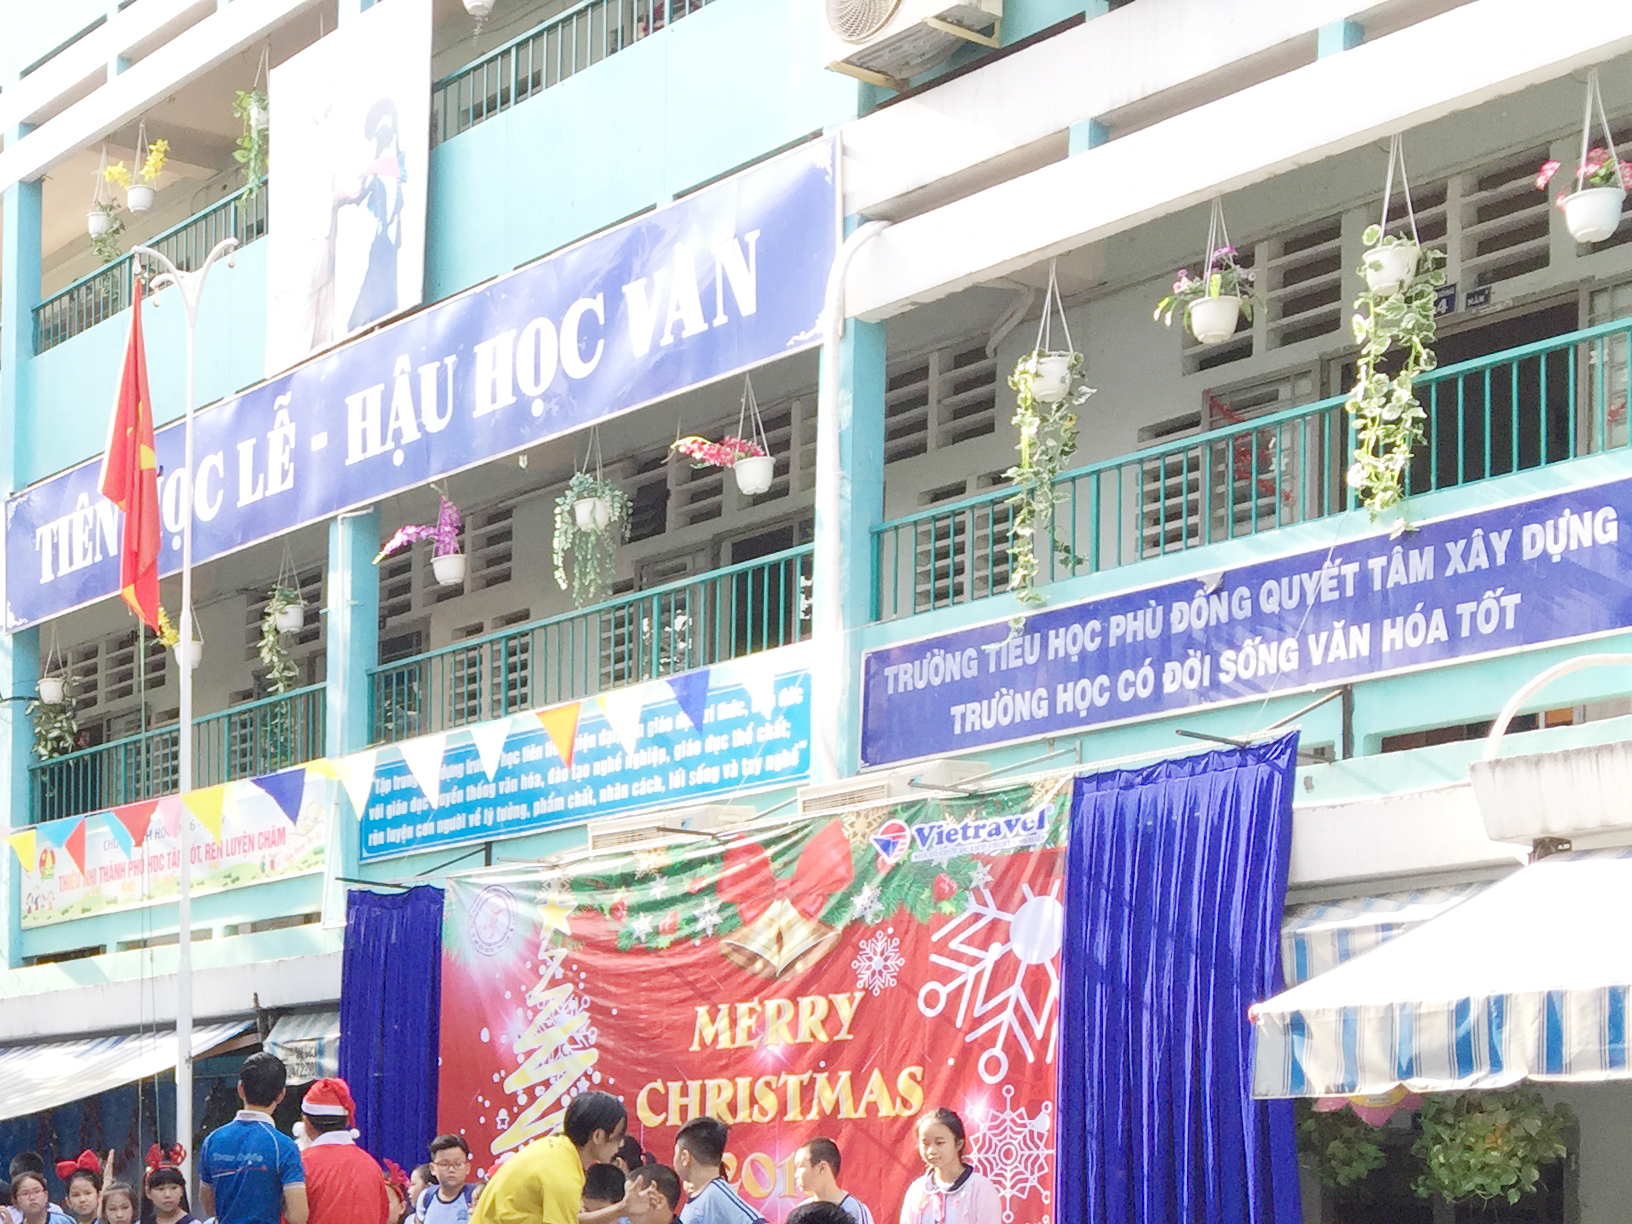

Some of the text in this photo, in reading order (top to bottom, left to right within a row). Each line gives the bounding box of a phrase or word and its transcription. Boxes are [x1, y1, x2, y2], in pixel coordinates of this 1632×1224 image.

[158, 451, 225, 551] ỌC
[236, 392, 296, 508] LỄ
[344, 353, 457, 467] HẬU
[473, 292, 606, 419] HỌC
[884, 649, 978, 695] TRƯỜNG
[1048, 624, 1103, 663] HỌC
[1109, 600, 1164, 647] PHÙ
[1260, 558, 1360, 615] QUYẾT
[1368, 546, 1434, 592] TÂM
[1445, 528, 1513, 577] XÂY
[1522, 506, 1619, 563] DỰNG
[950, 587, 1522, 735] TRƯỜNG HỌC CÓ ĐỜI SỐNG VĂN HÓA TỐT
[99, 857, 126, 883] THÀNH
[225, 828, 255, 861] LUYỆN
[257, 822, 287, 851] CHĂM
[915, 807, 1047, 848] Vietravel
[689, 991, 867, 1053] MERRY
[637, 1065, 926, 1128] CHRISTMAS
